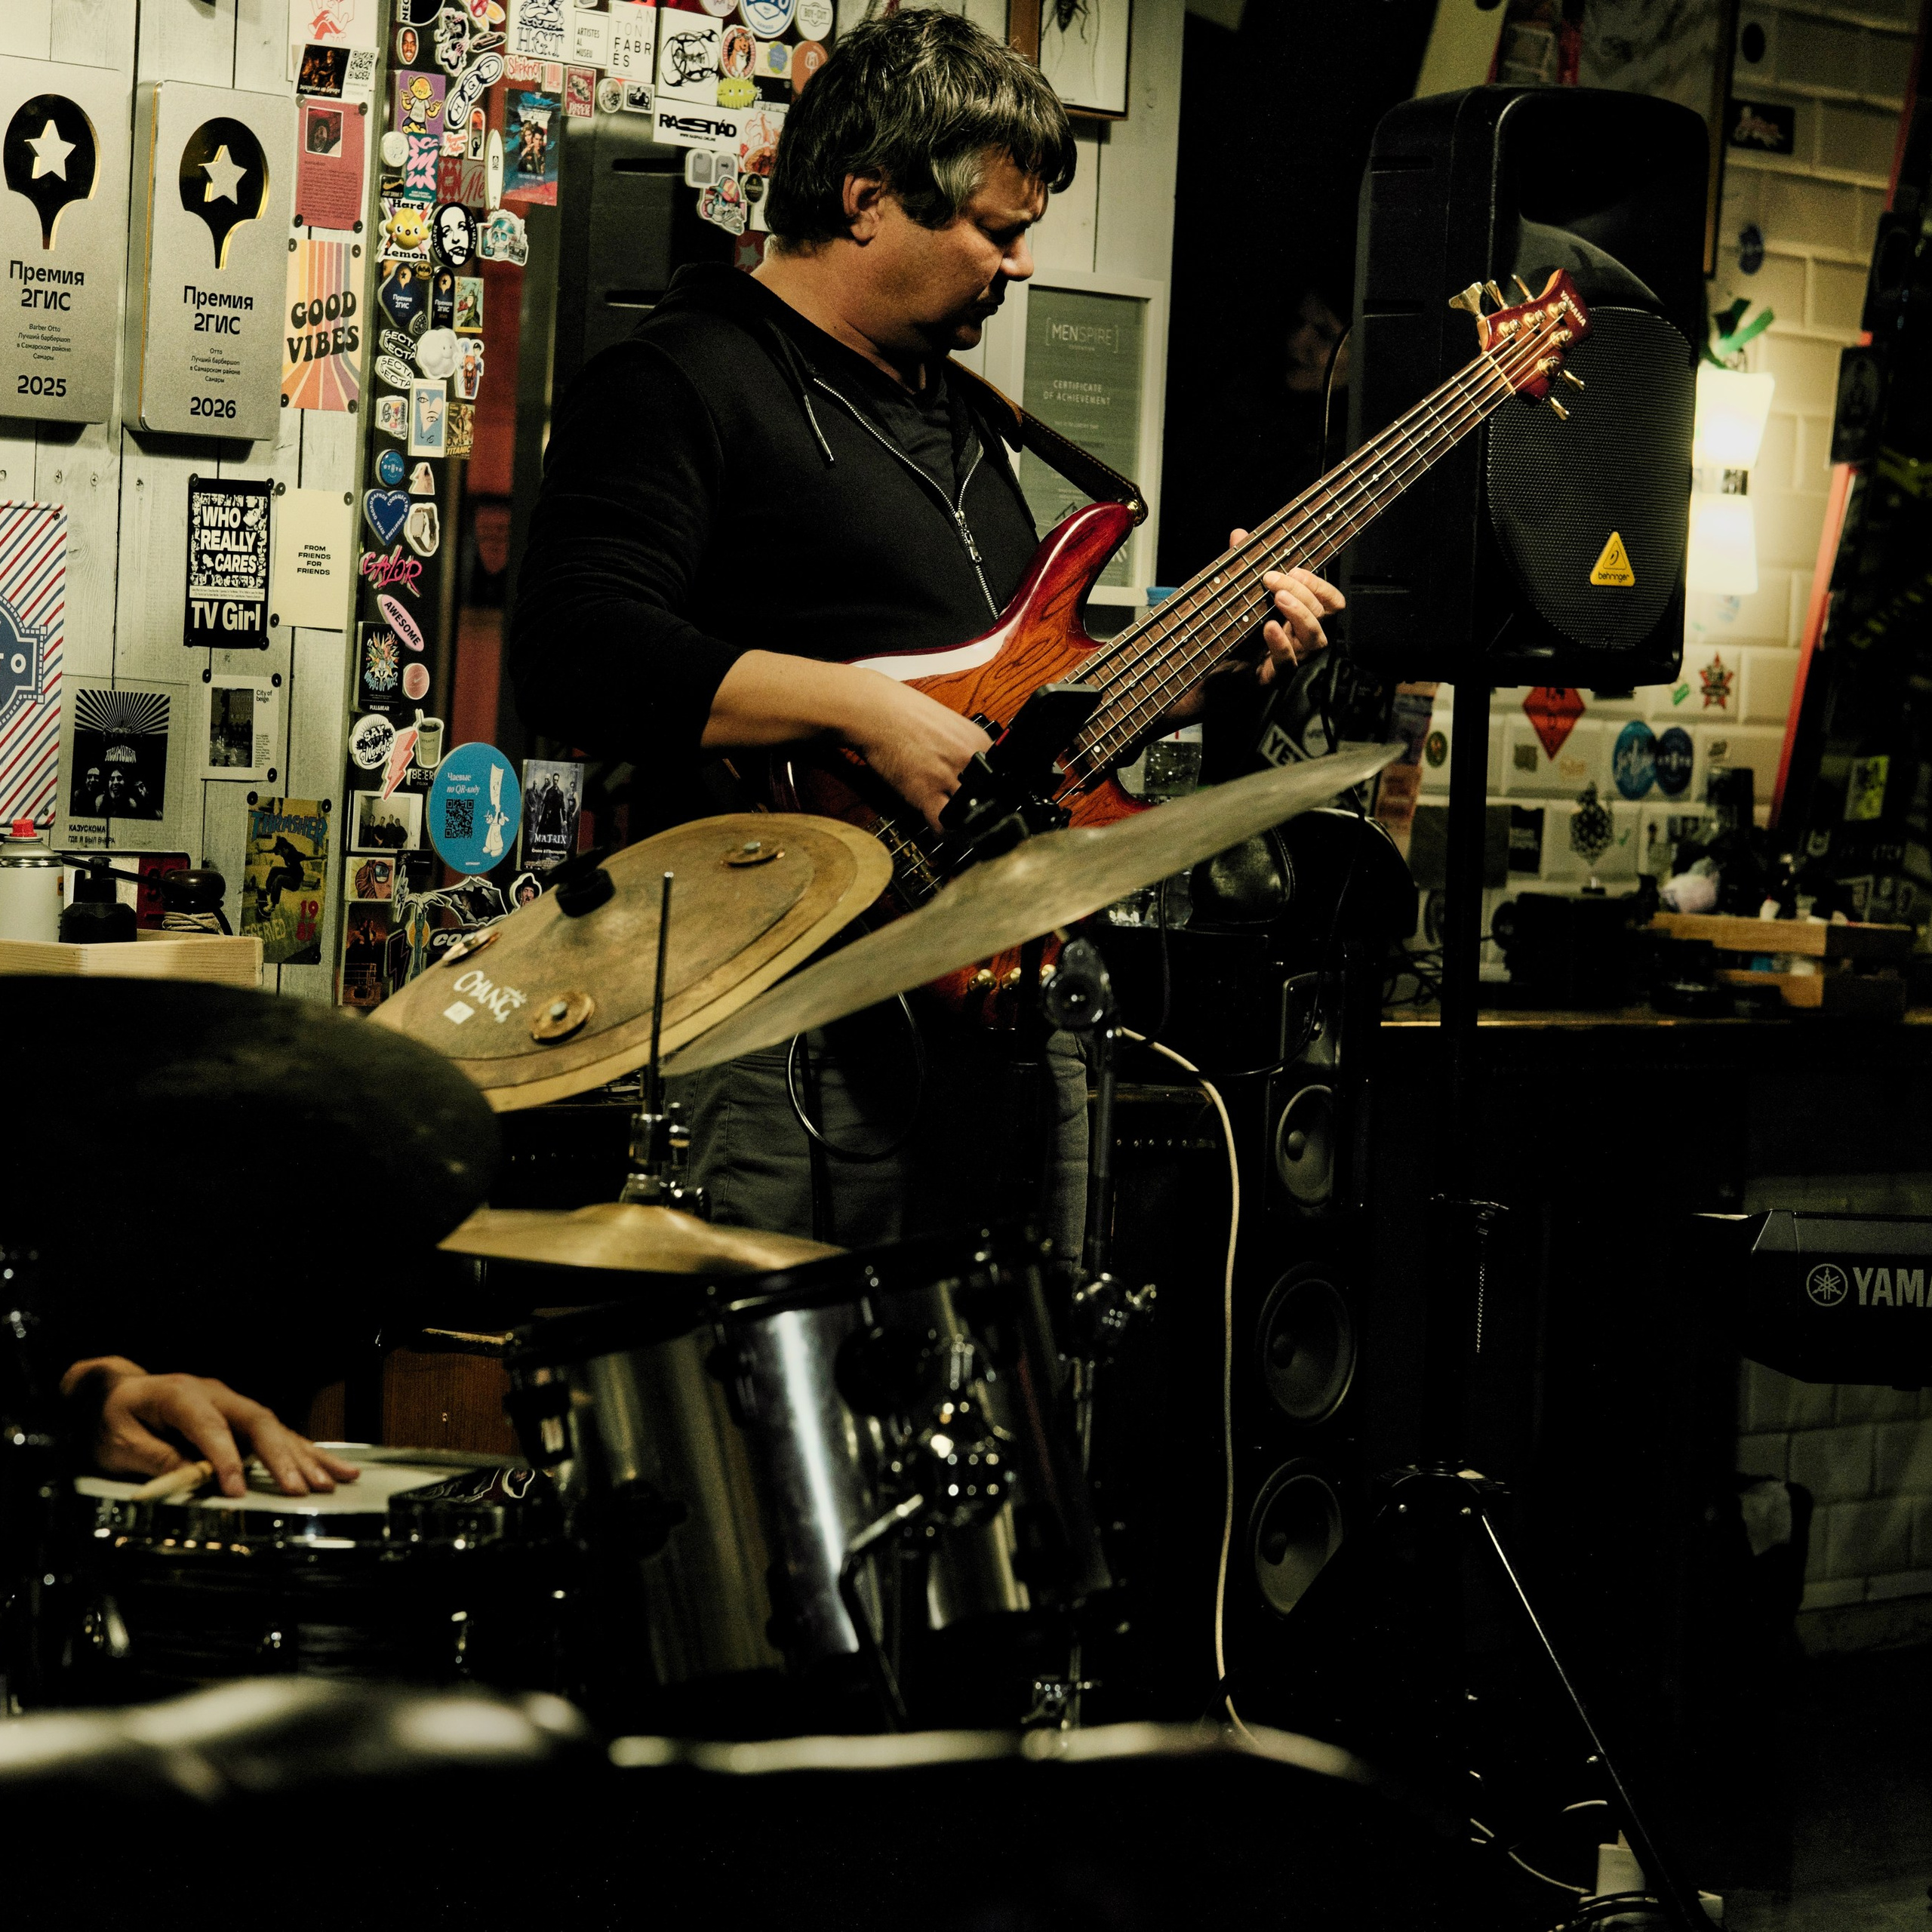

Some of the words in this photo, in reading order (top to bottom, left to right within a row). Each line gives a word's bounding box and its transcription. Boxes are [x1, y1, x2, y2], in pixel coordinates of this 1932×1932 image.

[577, 27, 600, 38] ARTISTES
[615, 20, 651, 38] TONI
[614, 37, 652, 55] FABR
[576, 48, 593, 58] MUSEU
[392, 199, 424, 211] Hard
[384, 248, 427, 260] Lemon
[10, 260, 85, 285] Премия
[21, 288, 71, 311] 2ГИС
[183, 285, 253, 310] Премия
[291, 291, 356, 329] GOOD
[1561, 290, 1586, 327] YAMAHA
[29, 323, 46, 331] Barber
[194, 312, 241, 335] 2ГИС
[18, 332, 40, 342] Лучший
[41, 334, 71, 343] барбершоп
[21, 342, 51, 352] Самарском
[287, 325, 359, 364] VIBES
[32, 352, 54, 361] Самары
[191, 355, 211, 365] Лучший
[212, 357, 240, 366] барбершоп
[194, 365, 222, 375] Самарском
[223, 368, 241, 376] районе
[17, 375, 67, 397] 2025
[205, 375, 225, 384] Самары
[1053, 380, 1102, 392] CERTIFICATE
[1056, 392, 1111, 405] ACHIEVEMENT
[190, 396, 236, 419] 2026
[447, 445, 471, 454] TITANIC
[202, 506, 242, 529] WHO
[200, 529, 257, 552] REALLY
[214, 553, 257, 574] CARES
[1598, 571, 1630, 583] behringer
[191, 601, 219, 629] TV
[222, 601, 260, 631] Girl
[384, 601, 421, 647] AWESOME
[256, 690, 267, 698] City
[448, 772, 472, 782] Чаевые
[455, 784, 480, 795] QR-коду
[251, 811, 328, 848] THRASHER
[534, 833, 566, 845] MATRIX
[300, 900, 318, 920] 19
